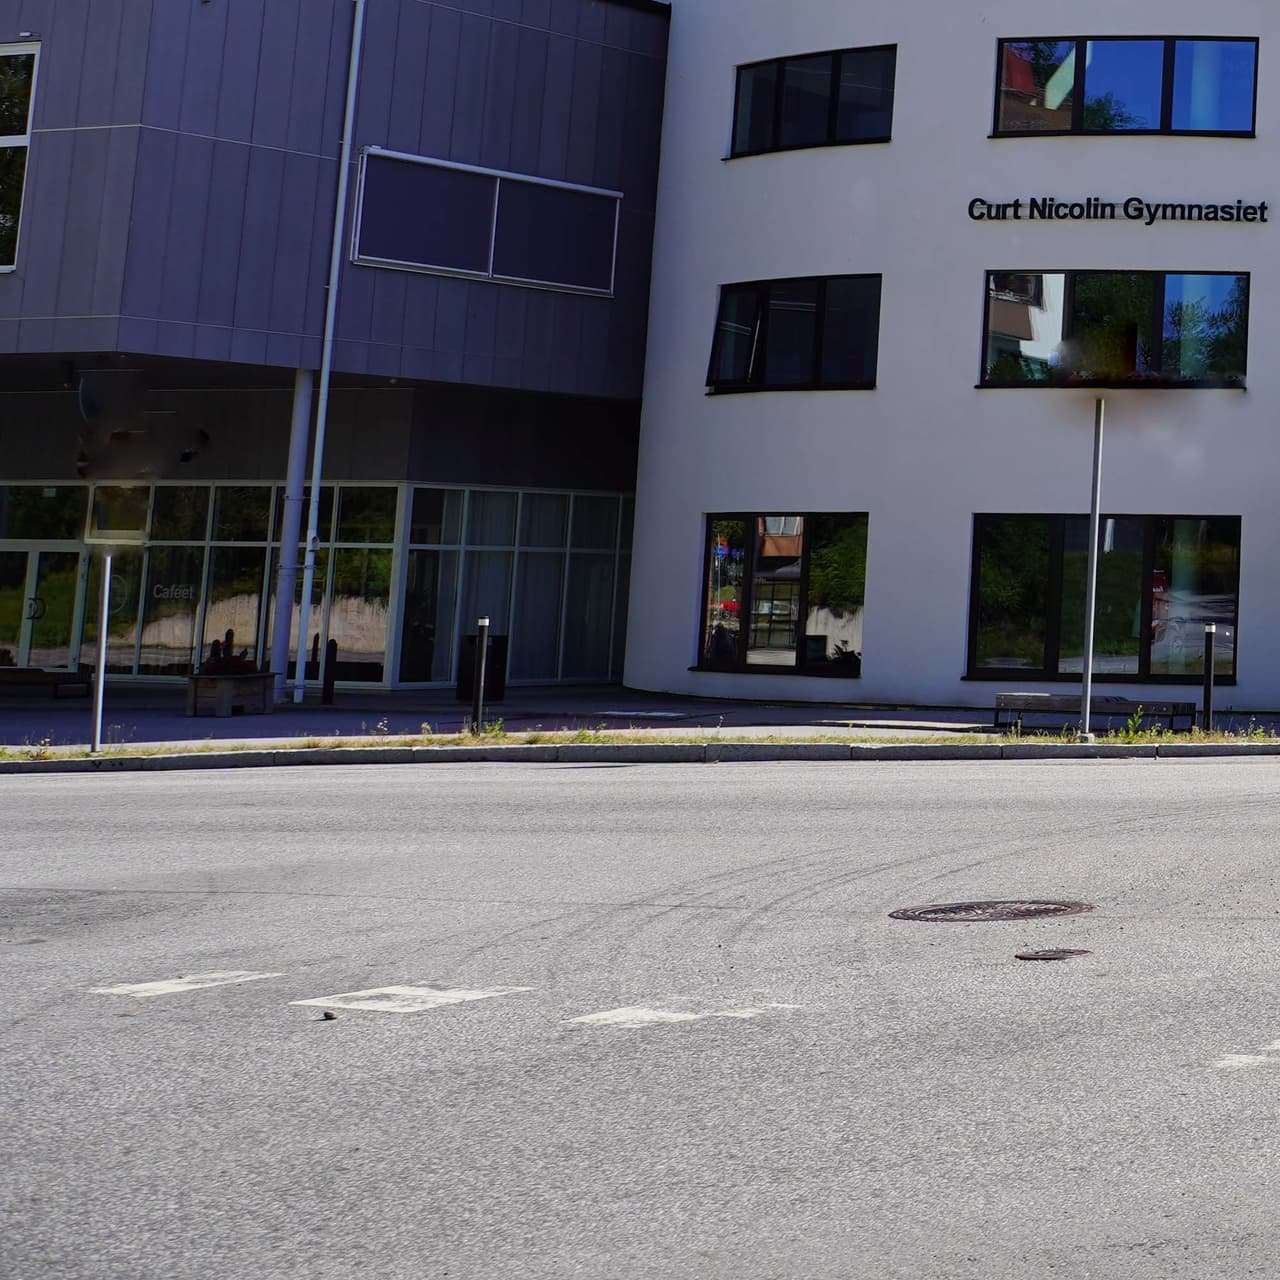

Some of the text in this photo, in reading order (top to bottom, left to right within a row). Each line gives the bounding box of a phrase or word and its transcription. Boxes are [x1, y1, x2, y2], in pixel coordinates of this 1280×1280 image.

[968, 197, 1269, 225] Curt Nicolin Gymnasiet
